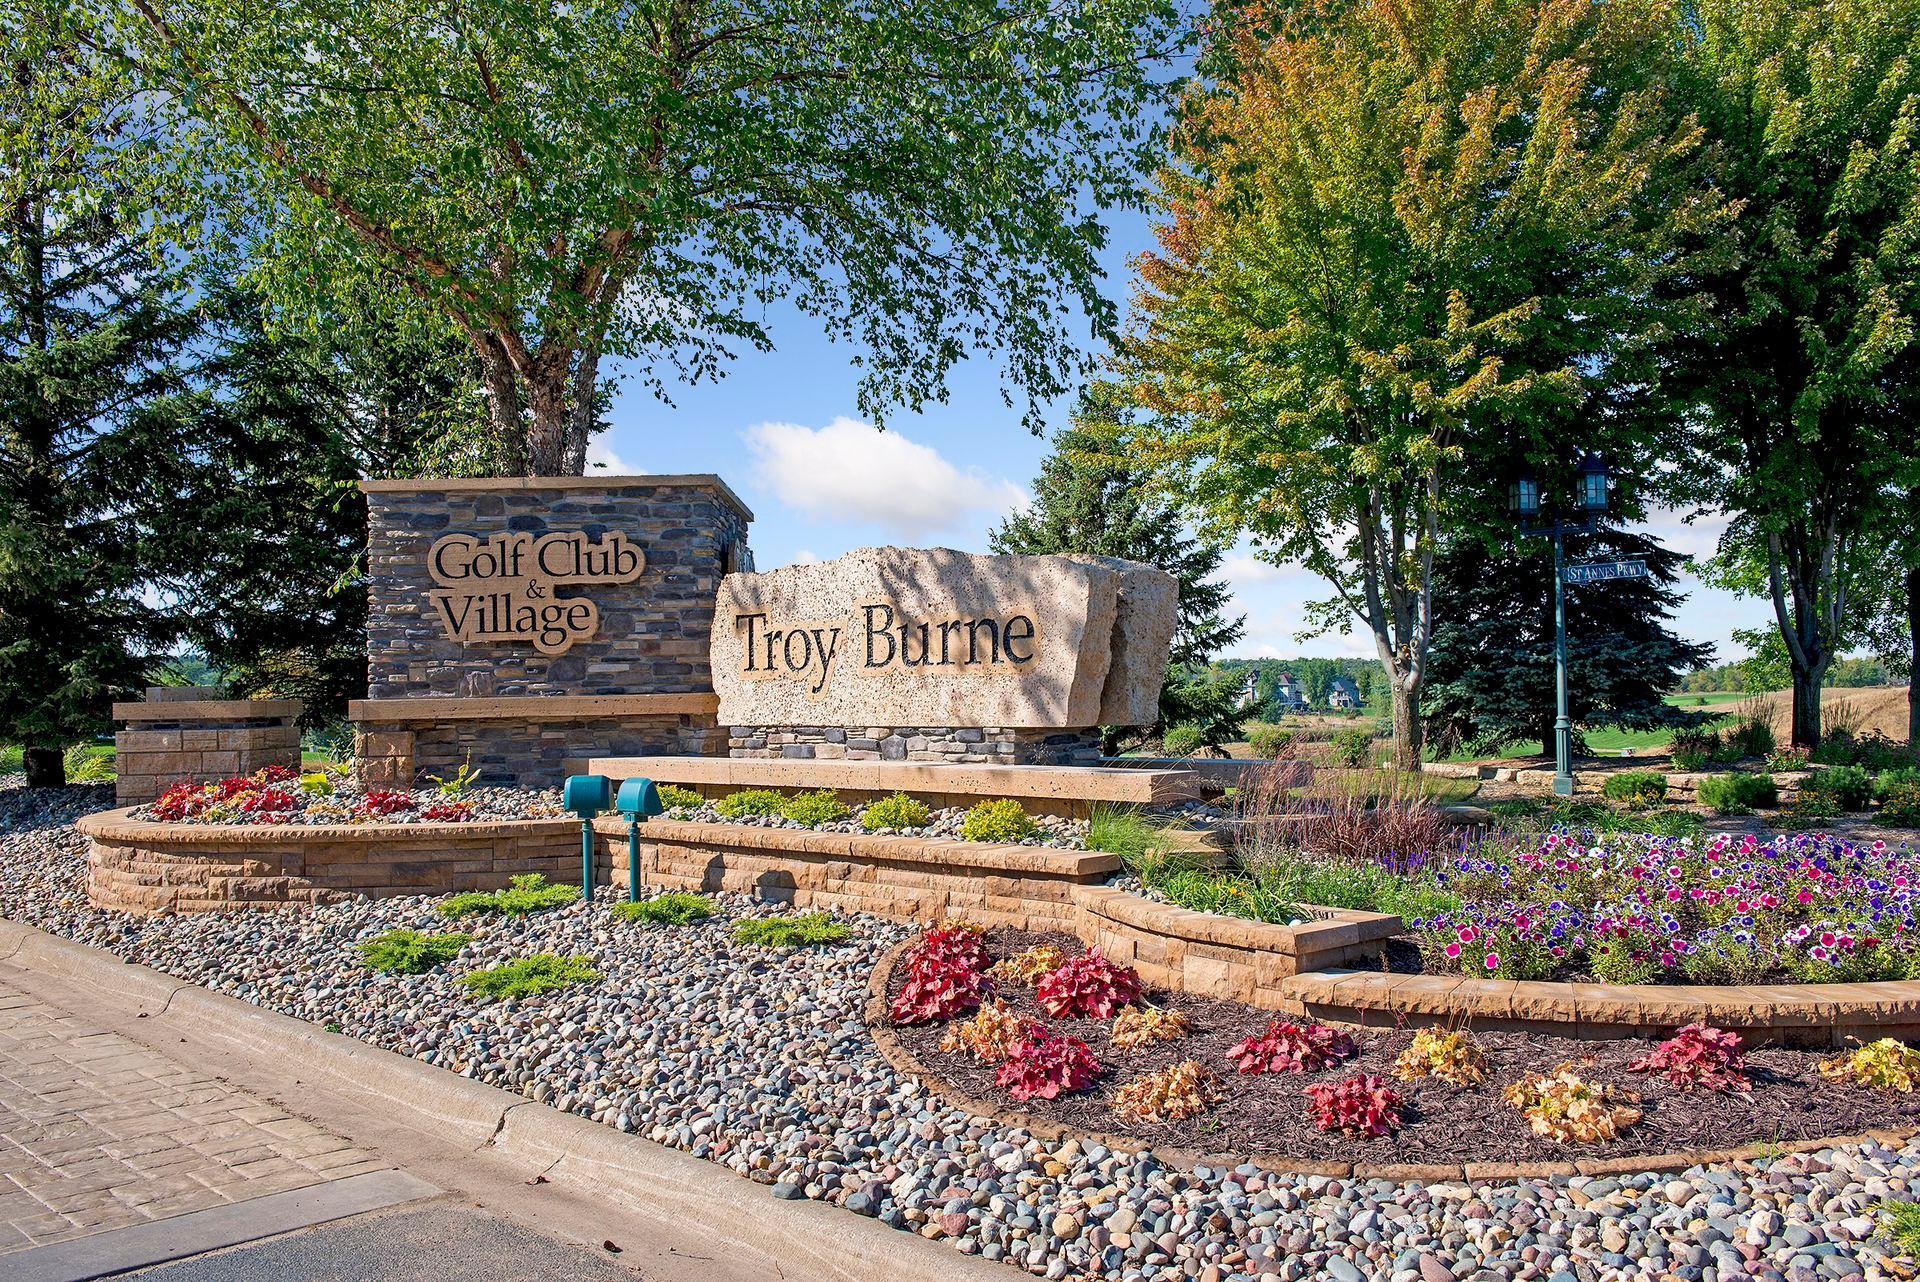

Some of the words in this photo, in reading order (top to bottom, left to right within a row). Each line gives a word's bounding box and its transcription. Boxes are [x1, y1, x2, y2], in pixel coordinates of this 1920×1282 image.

[435, 538, 526, 579] Golf
[538, 537, 638, 577] Club
[526, 579, 546, 599] &
[438, 593, 591, 647] Village
[736, 612, 841, 694] Troy
[861, 603, 1035, 669] Burne
